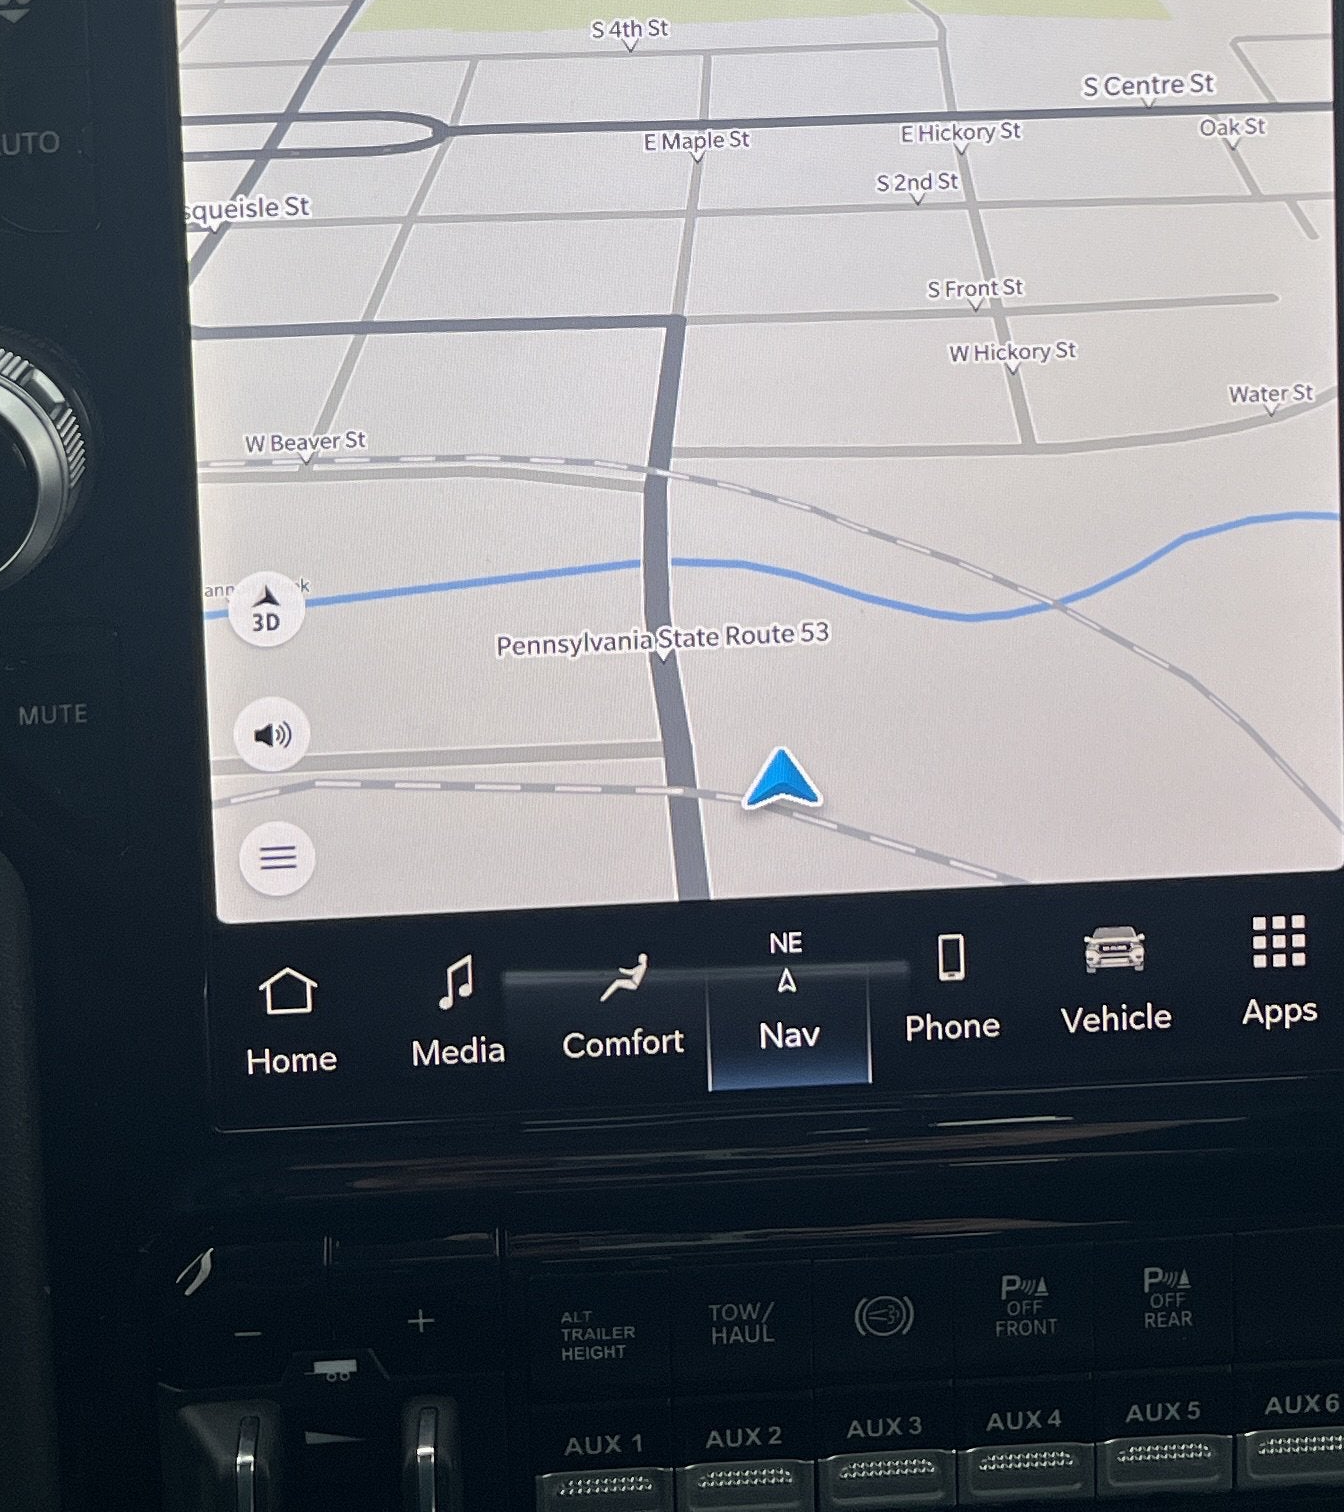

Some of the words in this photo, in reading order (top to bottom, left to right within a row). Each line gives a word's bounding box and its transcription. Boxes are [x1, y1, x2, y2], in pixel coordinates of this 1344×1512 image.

[592, 22, 604, 38] S
[608, 20, 642, 38] 4th
[648, 19, 668, 37] St
[1084, 77, 1097, 96] S
[1105, 75, 1183, 95] Centre
[1191, 73, 1213, 93] St
[902, 127, 912, 142] E
[920, 124, 996, 144] Hickory
[1001, 122, 1021, 138] St
[1200, 120, 1240, 137] Oak
[1246, 118, 1265, 135] St
[645, 135, 655, 150] E
[662, 132, 725, 152] Maple
[730, 131, 750, 147] St
[877, 175, 889, 191] S
[895, 173, 933, 191] 2nd
[938, 172, 958, 189] St
[285, 197, 309, 216] St
[928, 282, 940, 298] S
[946, 280, 997, 297] Front
[1003, 279, 1023, 295] St
[950, 346, 970, 362] W
[974, 343, 1050, 364] Hickory
[1056, 342, 1076, 358] St
[1230, 386, 1288, 402] Water
[1293, 384, 1313, 400] St
[246, 436, 264, 452] W
[271, 435, 340, 452] Beaver
[346, 431, 365, 448] St
[252, 613, 280, 631] 3D
[497, 630, 652, 657] Pennsylvania
[658, 628, 719, 648] State
[726, 625, 795, 645] Route
[800, 622, 829, 642] 53
[19, 703, 88, 726] MUTE
[770, 933, 802, 953] NE
[1060, 1003, 1172, 1034] Vehicle
[1243, 998, 1317, 1030] Apps
[760, 1023, 820, 1049] Nav
[905, 1015, 1000, 1041] Phone
[412, 1036, 505, 1066] Media
[563, 1030, 685, 1058] Comfort
[247, 1048, 337, 1075] Home
[1008, 1300, 1043, 1315] OFF
[1150, 1293, 1185, 1308] OFF
[561, 1311, 592, 1324] ALT
[709, 1302, 774, 1323] TOW/
[1145, 1311, 1192, 1329] REAR
[562, 1327, 635, 1341] TRAILER
[712, 1325, 774, 1345] HAUL
[996, 1319, 1057, 1336] FRONT
[562, 1345, 626, 1361] HEIGHT
[1125, 1402, 1180, 1423] AUX
[1188, 1402, 1201, 1420] 5
[1264, 1394, 1321, 1415] AUX
[1324, 1393, 1340, 1413] 6
[848, 1418, 904, 1438] AUX
[909, 1416, 923, 1435] 3
[986, 1411, 1042, 1431] AUX
[1048, 1409, 1062, 1427] 4
[564, 1435, 622, 1456] AUX
[632, 1434, 642, 1453] 1
[706, 1428, 761, 1448] AUX
[768, 1426, 782, 1445] 2
